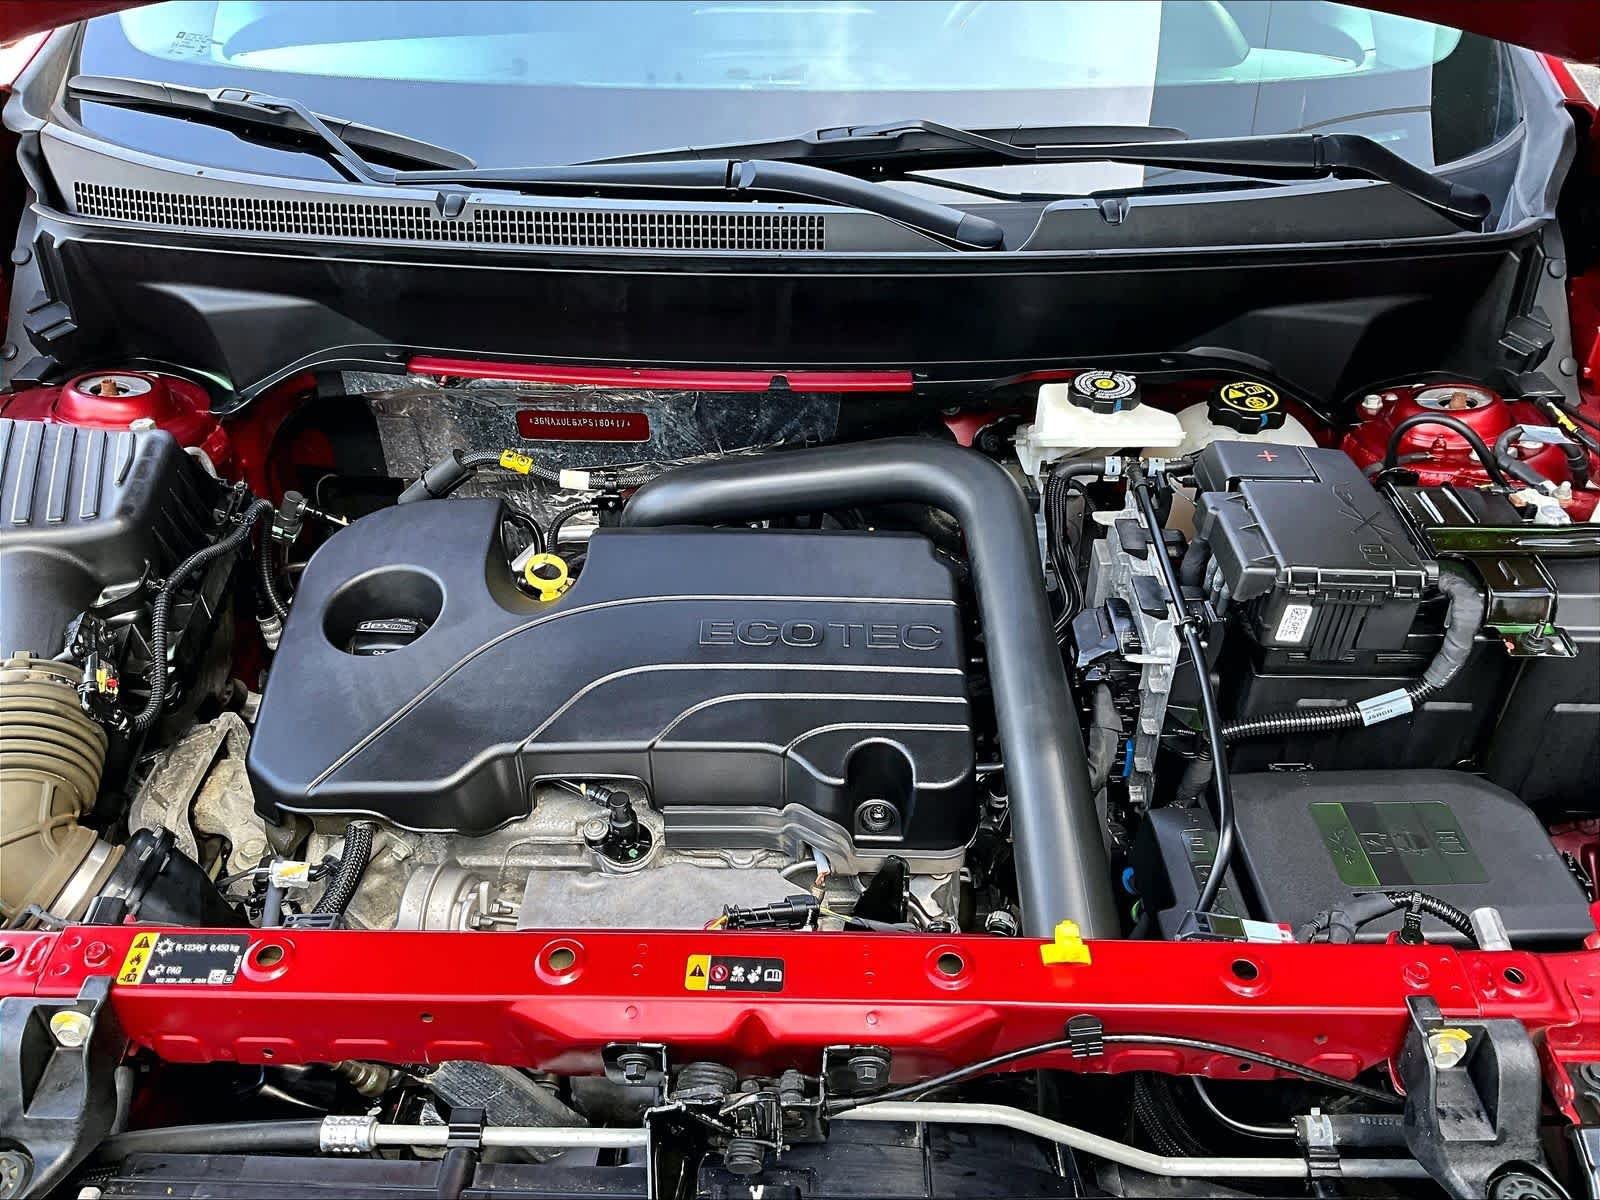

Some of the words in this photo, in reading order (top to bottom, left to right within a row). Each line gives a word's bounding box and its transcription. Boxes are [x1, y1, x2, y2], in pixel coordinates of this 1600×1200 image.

[698, 619, 944, 651] ECOTEC
[209, 944, 230, 952] 0.450
[166, 967, 182, 975] PAG
